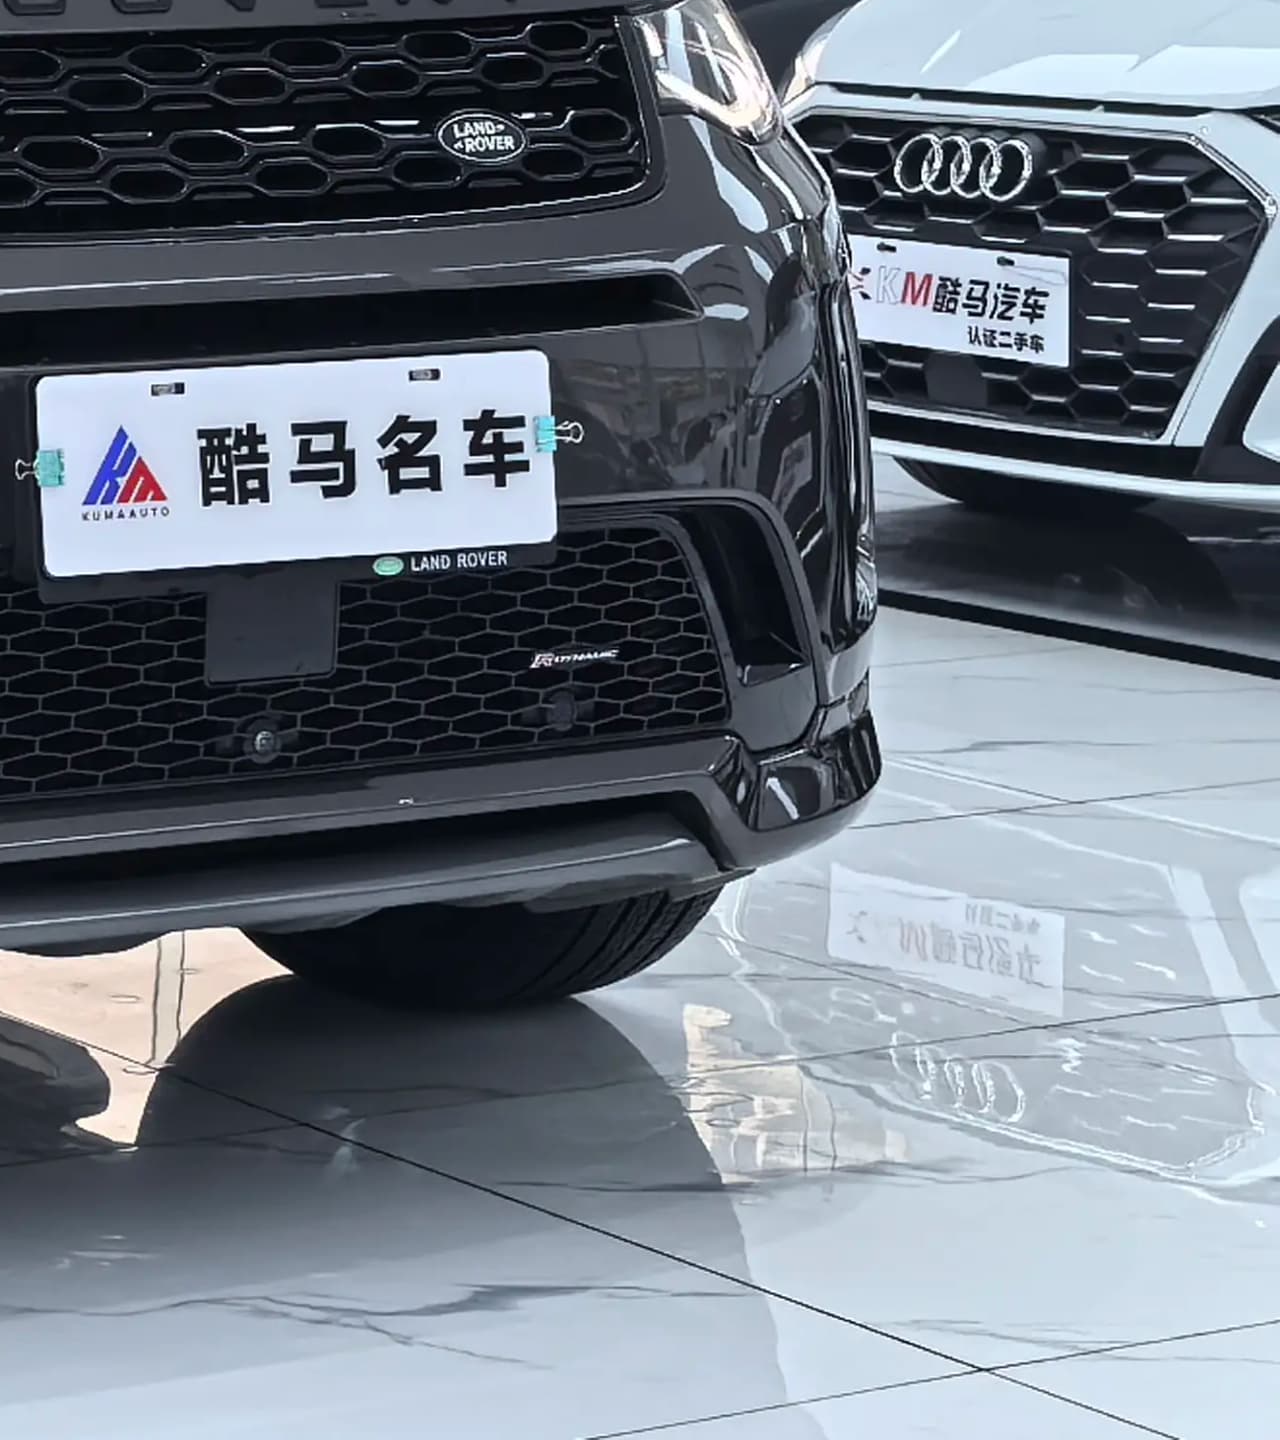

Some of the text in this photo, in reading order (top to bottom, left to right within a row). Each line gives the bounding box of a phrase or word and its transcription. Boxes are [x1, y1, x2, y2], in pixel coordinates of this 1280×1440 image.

[453, 121, 496, 139] LAND
[463, 135, 515, 153] ROVER
[196, 409, 530, 508] 酷马名车
[411, 555, 451, 572] LAND
[457, 550, 508, 568] ROVER
